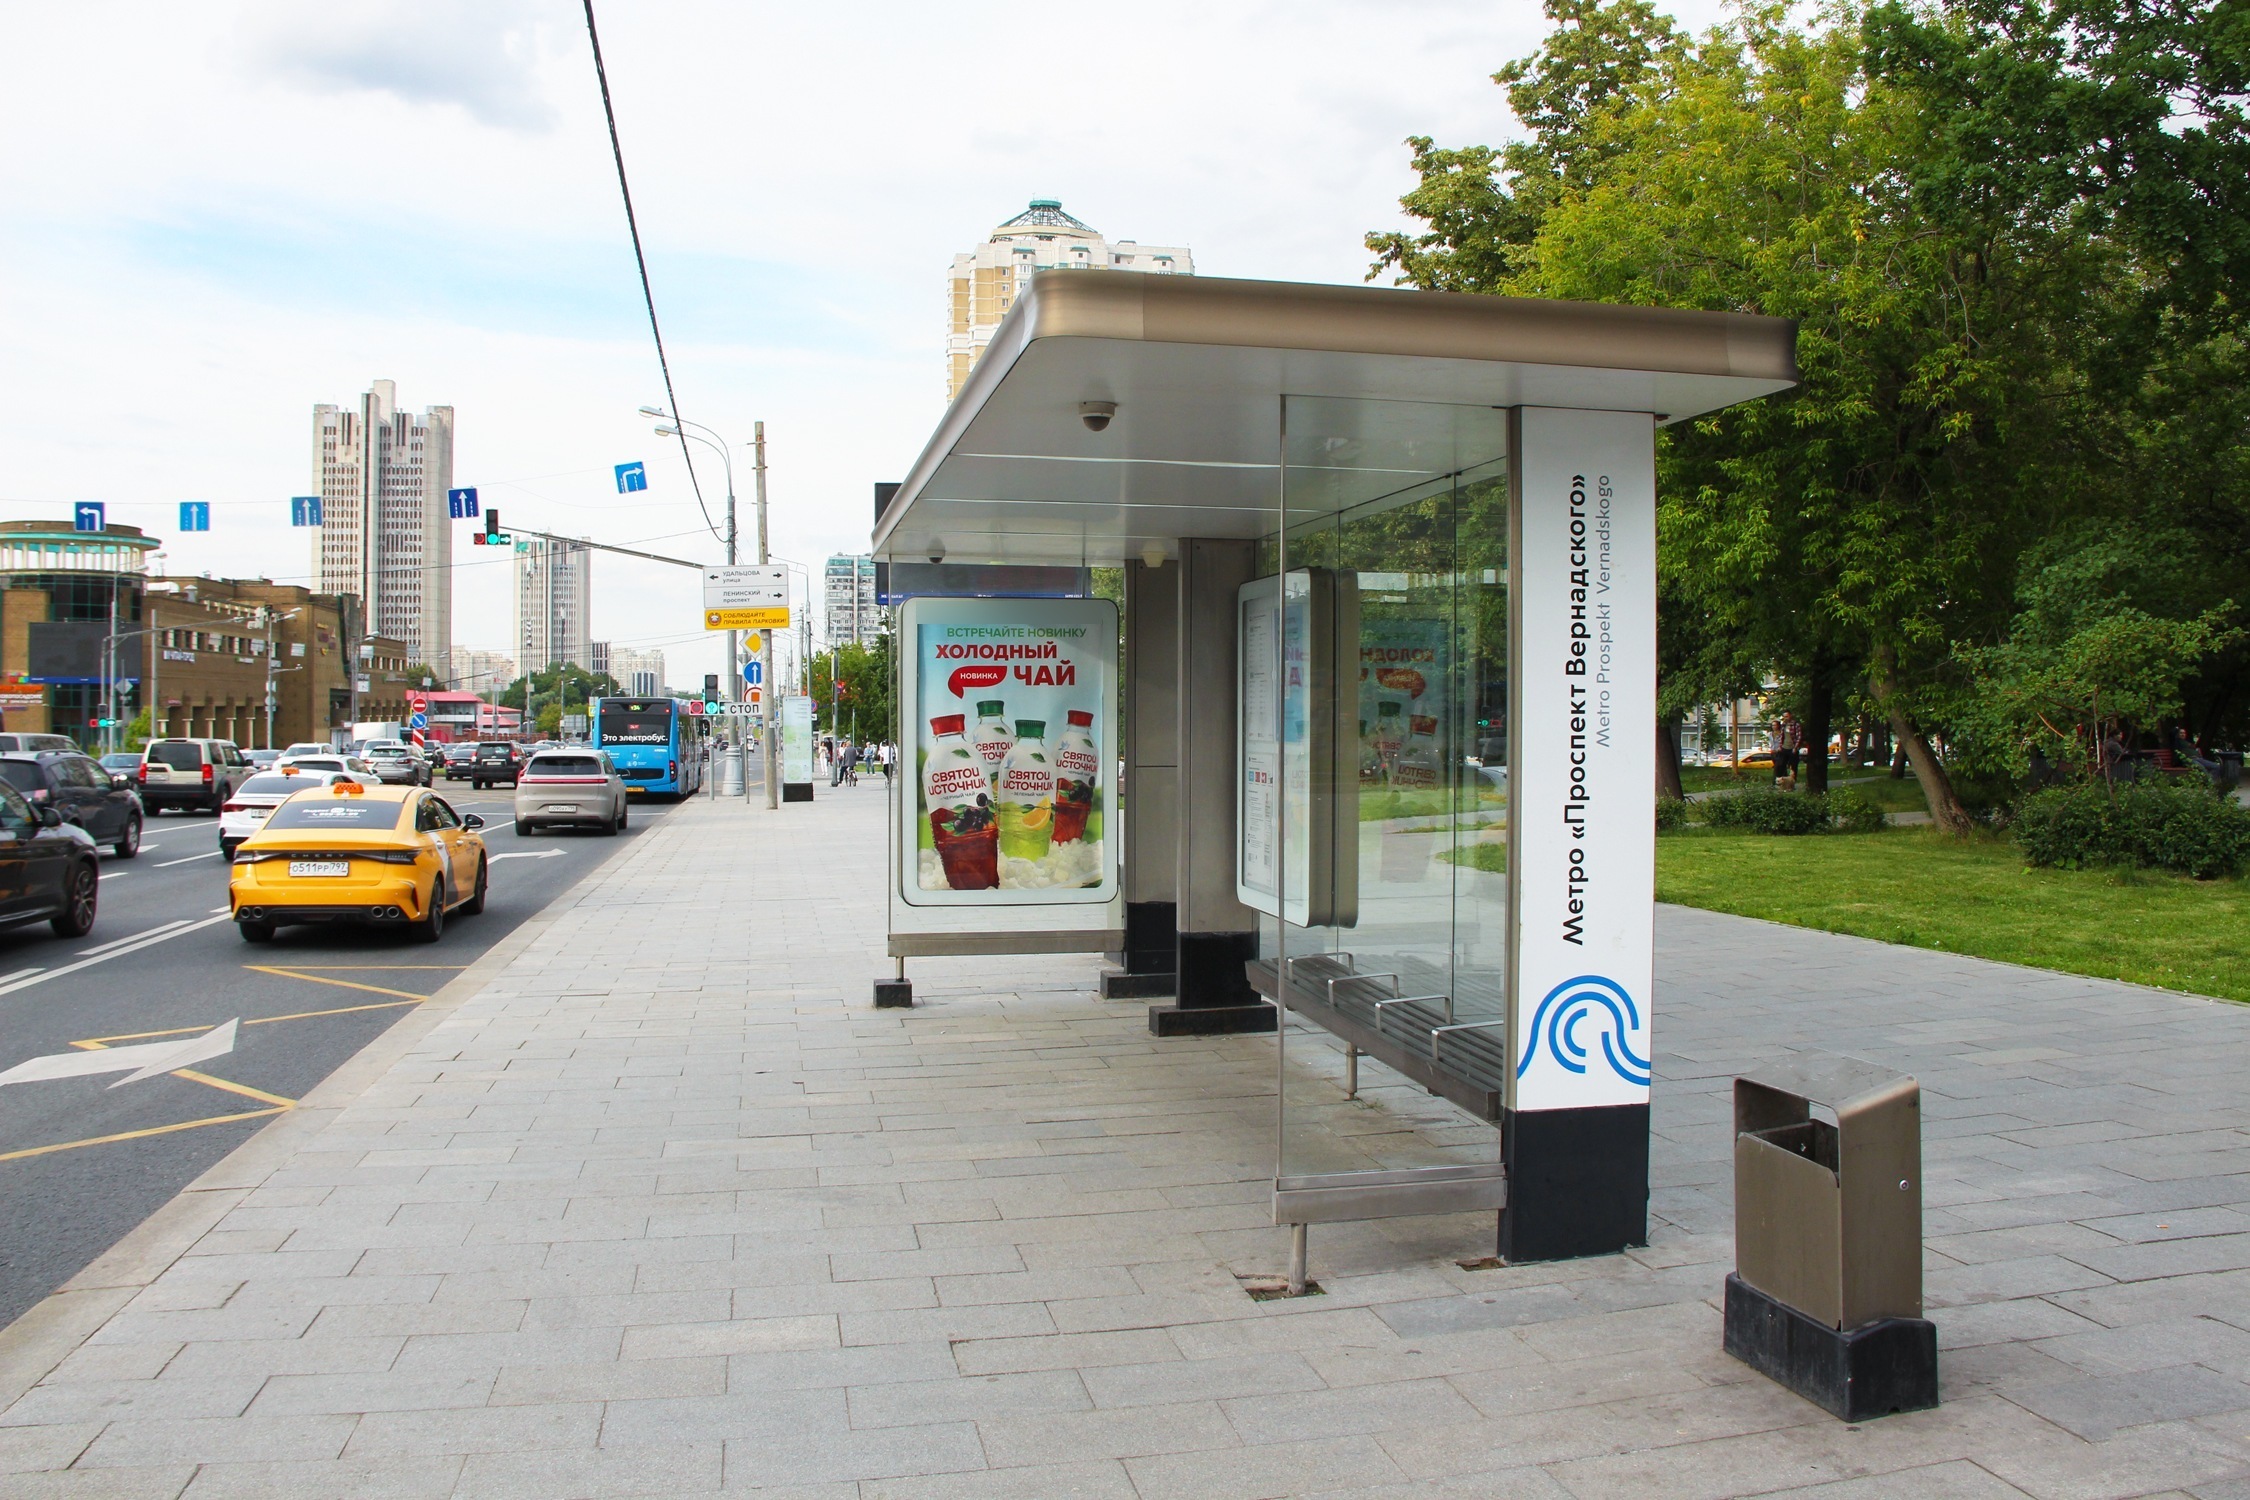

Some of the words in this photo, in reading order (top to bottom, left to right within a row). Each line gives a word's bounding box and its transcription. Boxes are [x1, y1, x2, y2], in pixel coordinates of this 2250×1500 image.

[1594, 474, 1613, 595] Vernadskogo
[722, 569, 761, 577] УДАЛЬЦОВА
[1565, 473, 1592, 676] Вернадского»
[723, 589, 761, 597] ЛЕНИНСКИЙ
[723, 611, 766, 619] СОБЛЮДАЙТЕ
[947, 626, 1025, 638] ВСТРЕЧАЙТЕ
[1028, 627, 1087, 638] НОВИНКУ
[935, 641, 1057, 661] ХОЛОДНЫЙ
[1595, 602, 1613, 684] Prospekt
[960, 672, 999, 680] НОВИНКА
[1013, 659, 1075, 686] ЧАЙ
[729, 703, 760, 714] СТОП
[1596, 690, 1610, 748] Metro
[602, 734, 618, 742] Это
[619, 733, 669, 743] электробус.
[1564, 684, 1589, 840] «Проспект
[928, 777, 987, 796] ИСТОЧНИК
[1002, 779, 1054, 791] ИСТОЧНИК
[1562, 848, 1588, 946] Метро
